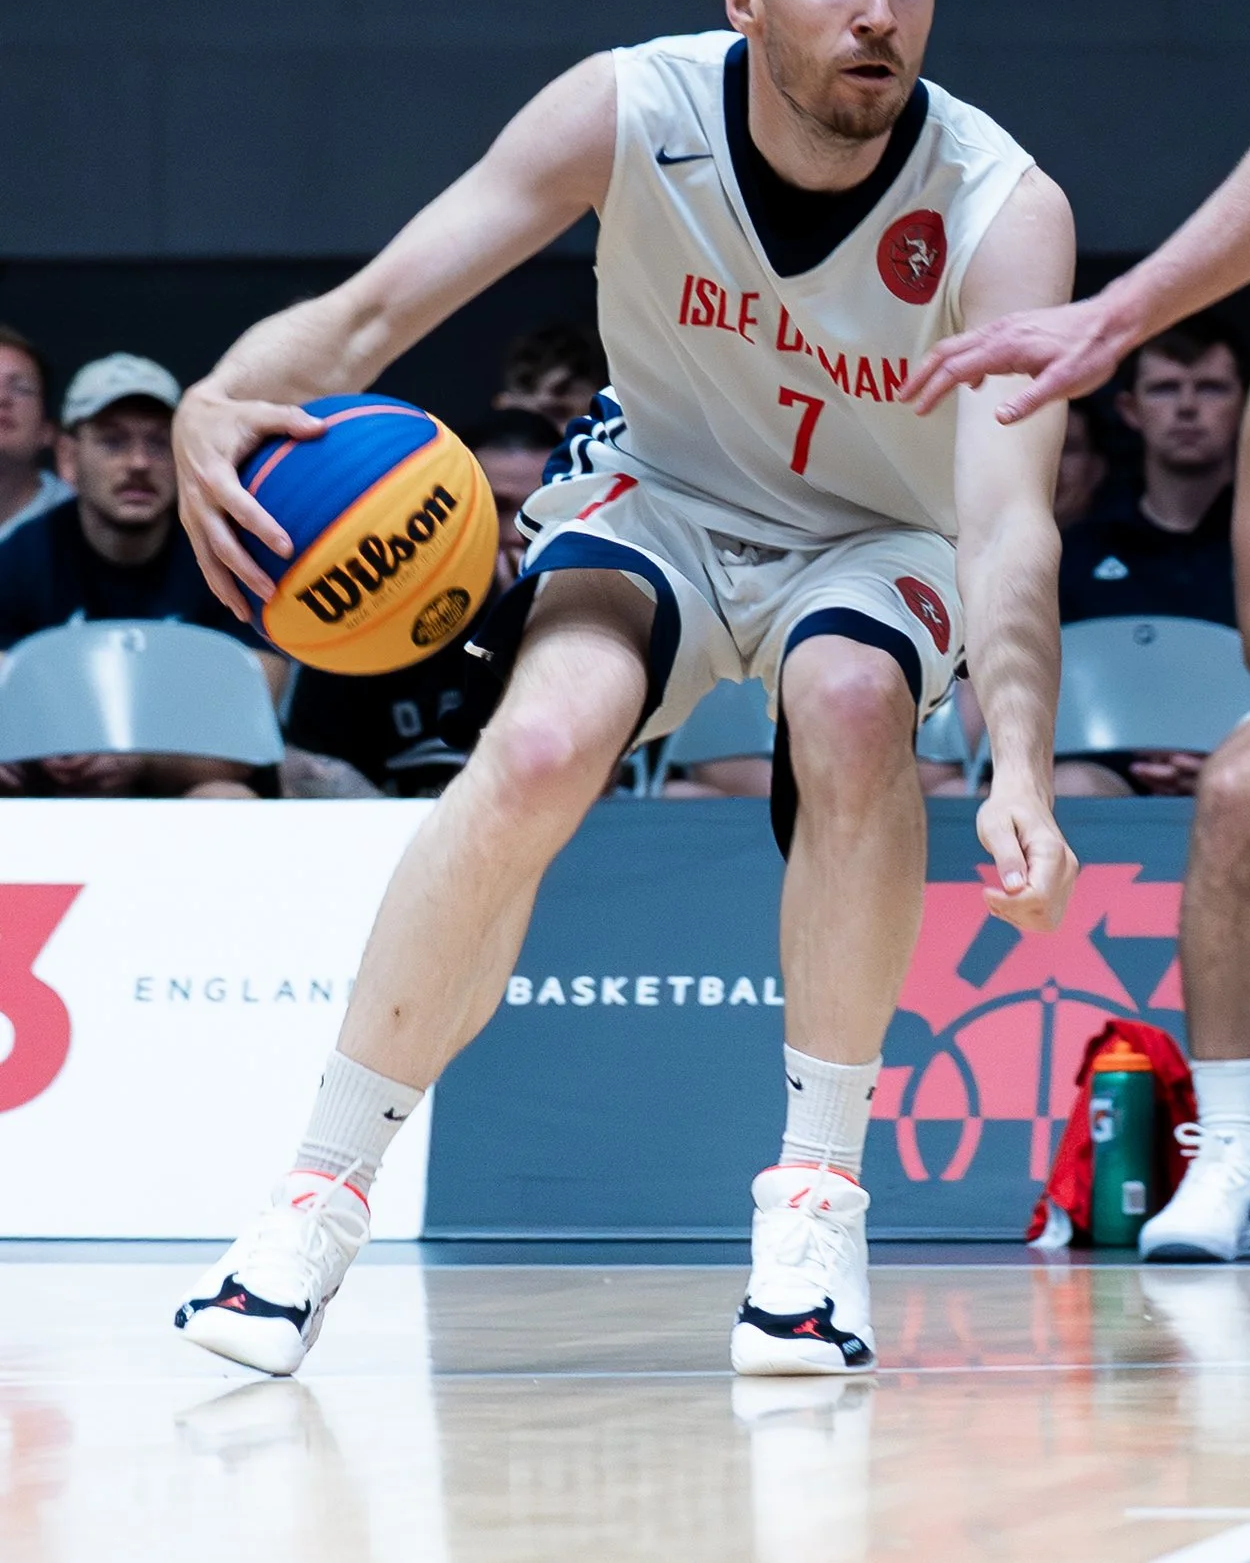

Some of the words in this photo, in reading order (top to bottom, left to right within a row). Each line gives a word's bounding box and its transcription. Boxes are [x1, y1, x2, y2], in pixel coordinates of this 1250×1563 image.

[679, 274, 759, 345] ISLE
[817, 344, 908, 403] MAN
[778, 385, 825, 476] 7
[294, 484, 458, 625] Wilson
[134, 976, 357, 1002] ENGLAN
[506, 975, 785, 1006] BASKETBAL
